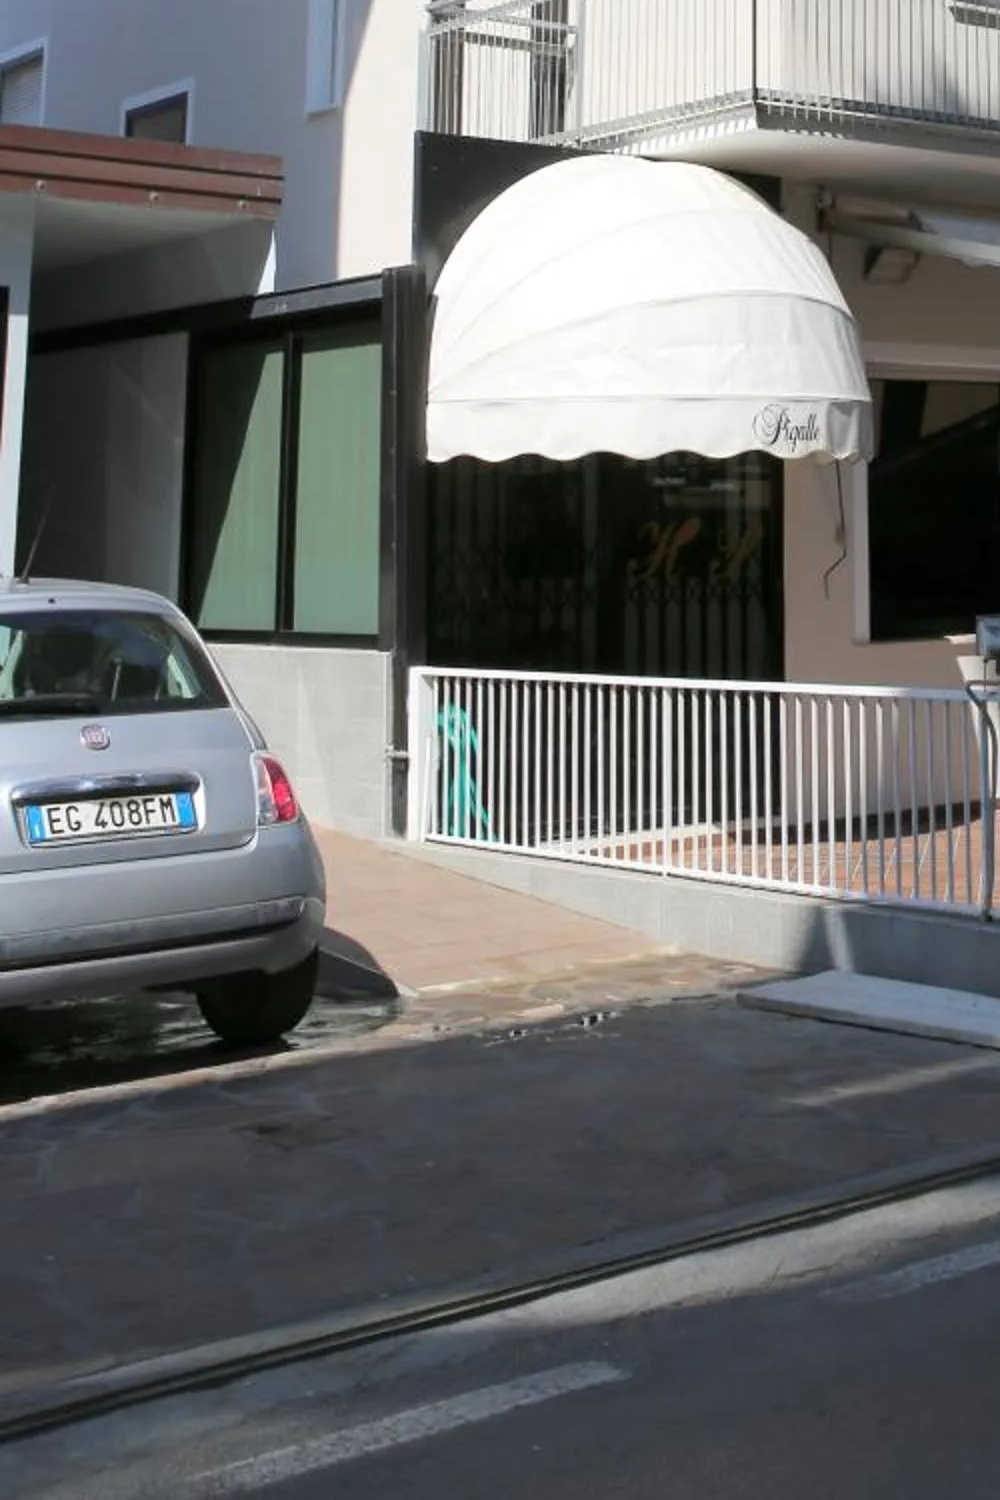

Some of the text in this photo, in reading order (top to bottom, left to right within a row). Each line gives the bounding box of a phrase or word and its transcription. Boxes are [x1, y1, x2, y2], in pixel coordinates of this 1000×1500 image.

[752, 403, 820, 452] Pigalle
[47, 797, 177, 834] EG 408FM
